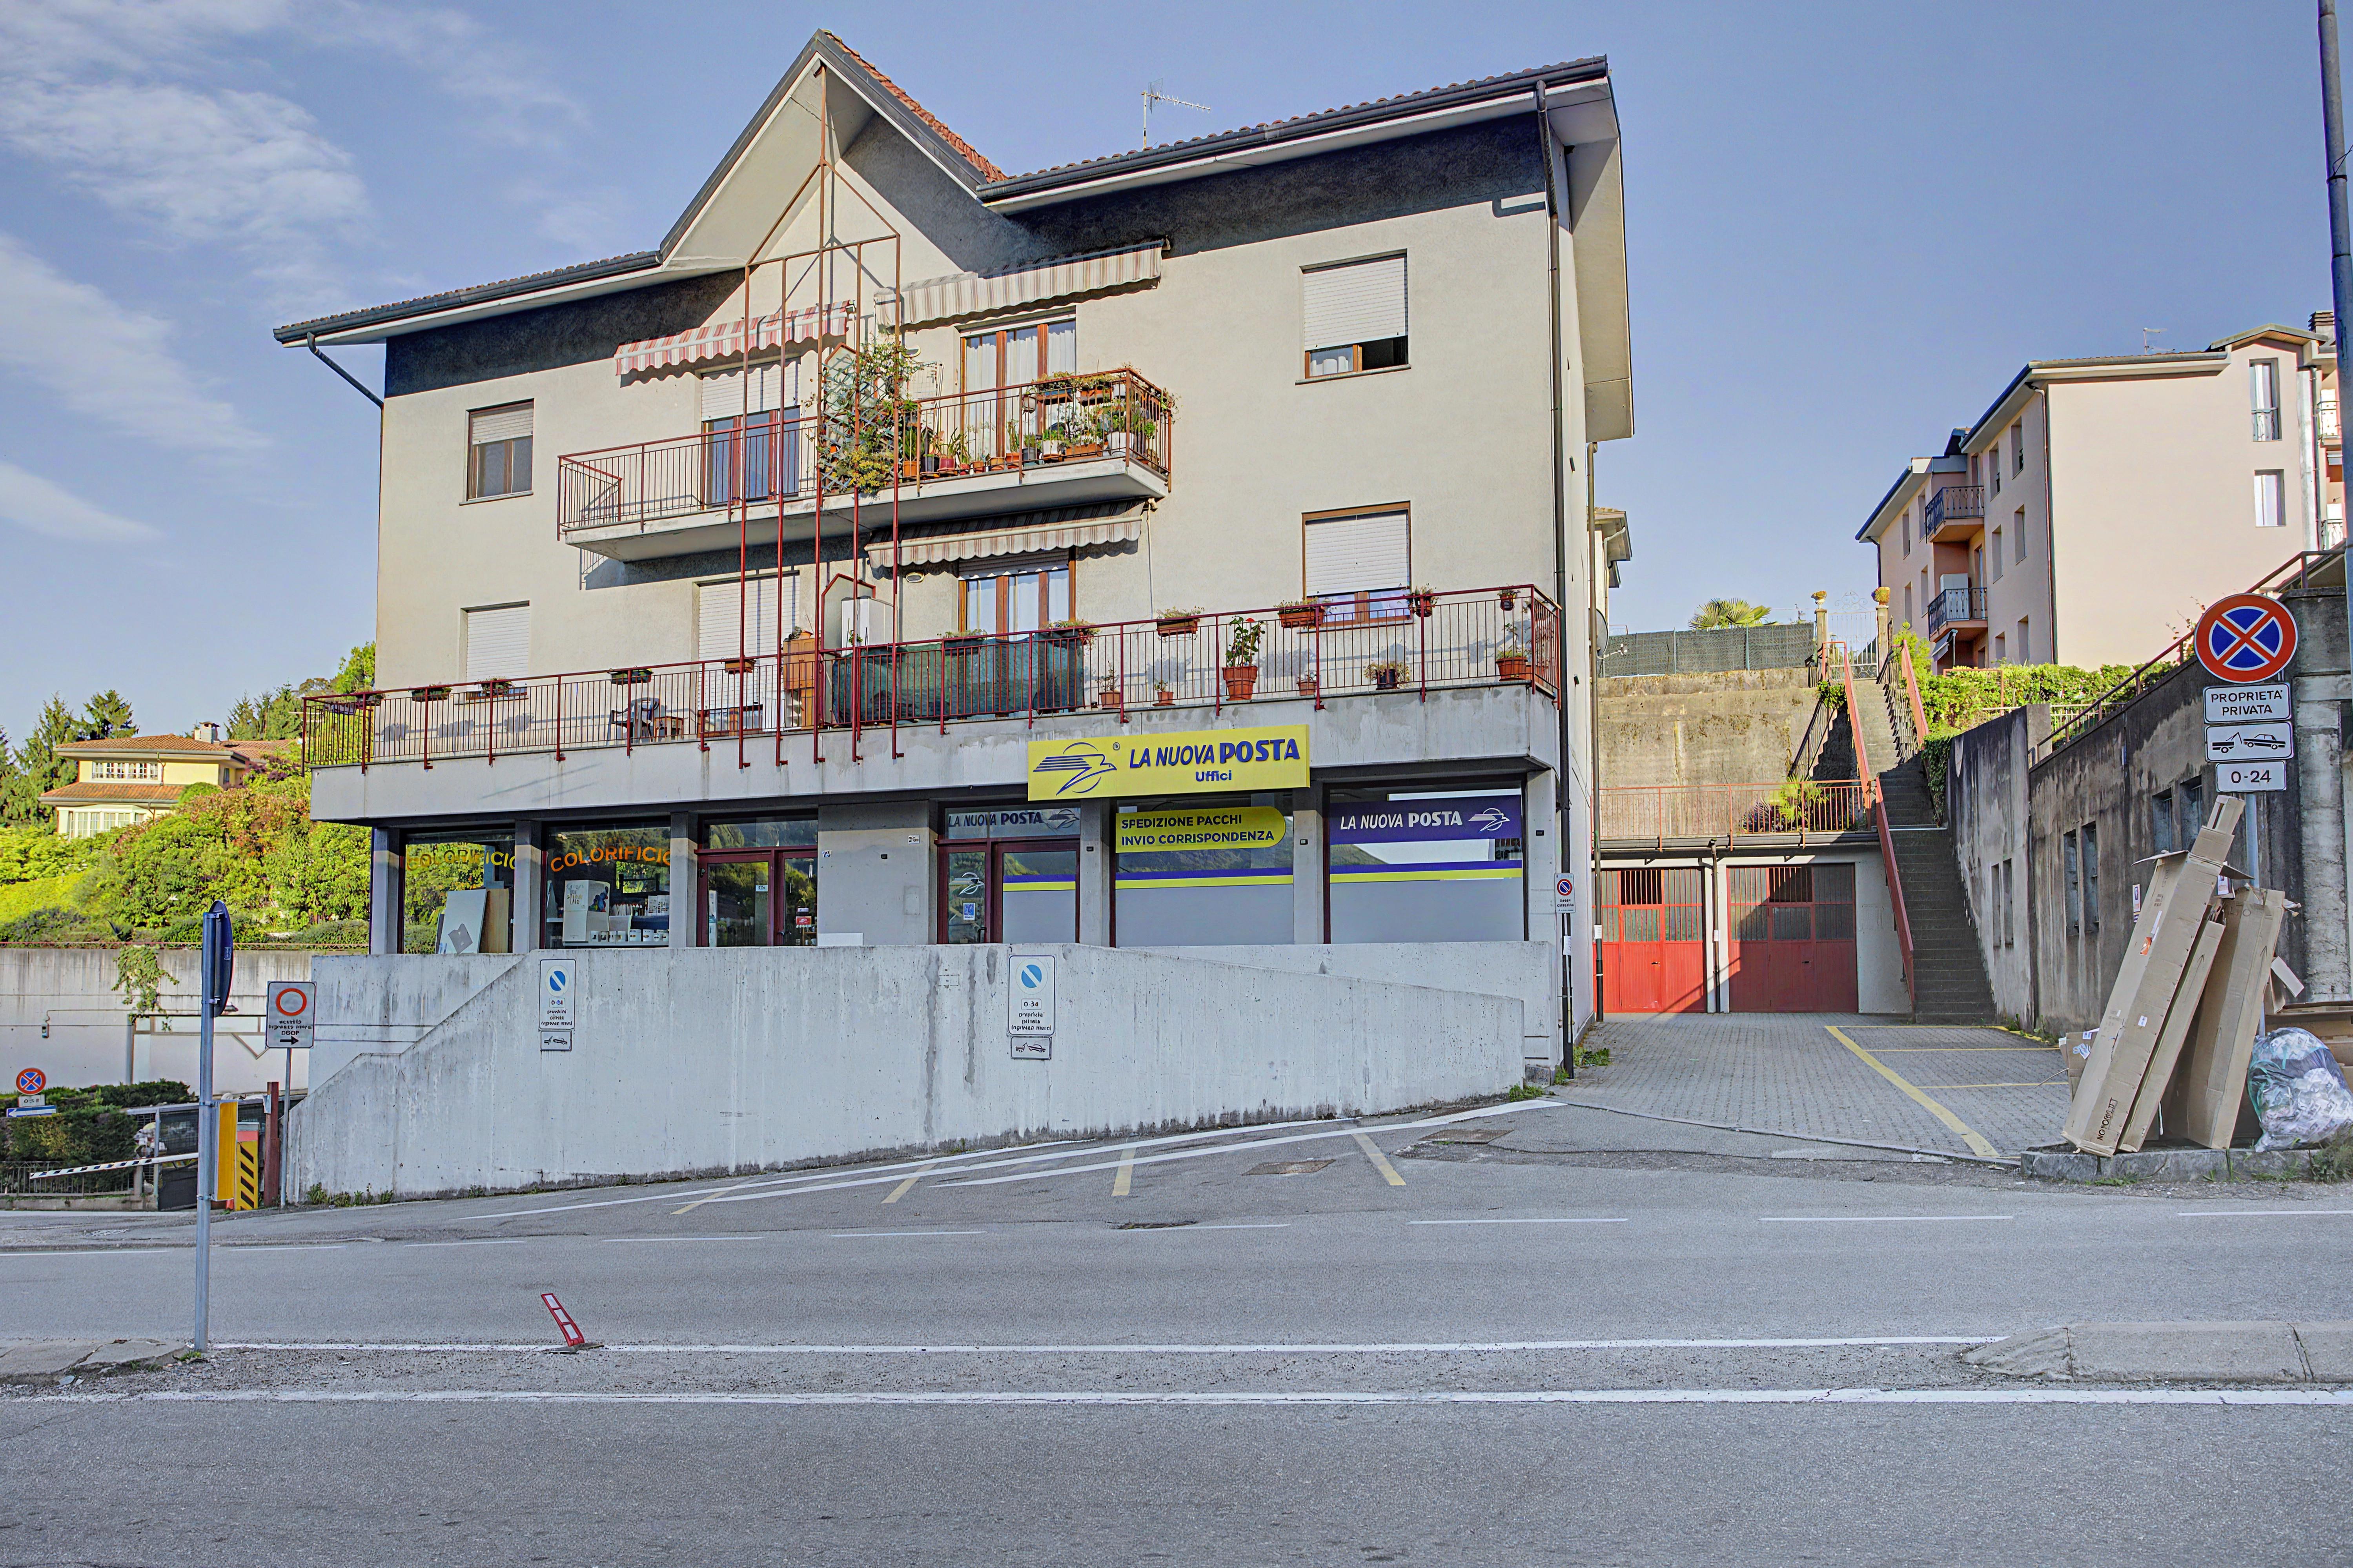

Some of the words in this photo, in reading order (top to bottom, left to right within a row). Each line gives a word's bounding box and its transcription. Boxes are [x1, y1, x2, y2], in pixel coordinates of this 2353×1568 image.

[2211, 690, 2283, 703] PROPRIETA'
[2222, 705, 2273, 716] PRIVATA
[1129, 748, 1151, 768] LA
[1156, 744, 1215, 766] NUOVA
[1220, 738, 1300, 764] POSTA
[1195, 769, 1232, 782] Uffici
[948, 815, 960, 827] LA
[963, 814, 997, 827] NUOVA
[1001, 812, 1044, 825] POSTA
[1122, 816, 1193, 829] SPEDIZIONE
[1197, 814, 1242, 825] PACCHI
[1340, 816, 1356, 830] LA
[1360, 813, 1403, 829] NUOVA
[1408, 811, 1462, 827] POSTA
[1122, 835, 1155, 846] INVIO
[1158, 830, 1274, 844] CORRISPONDENZA
